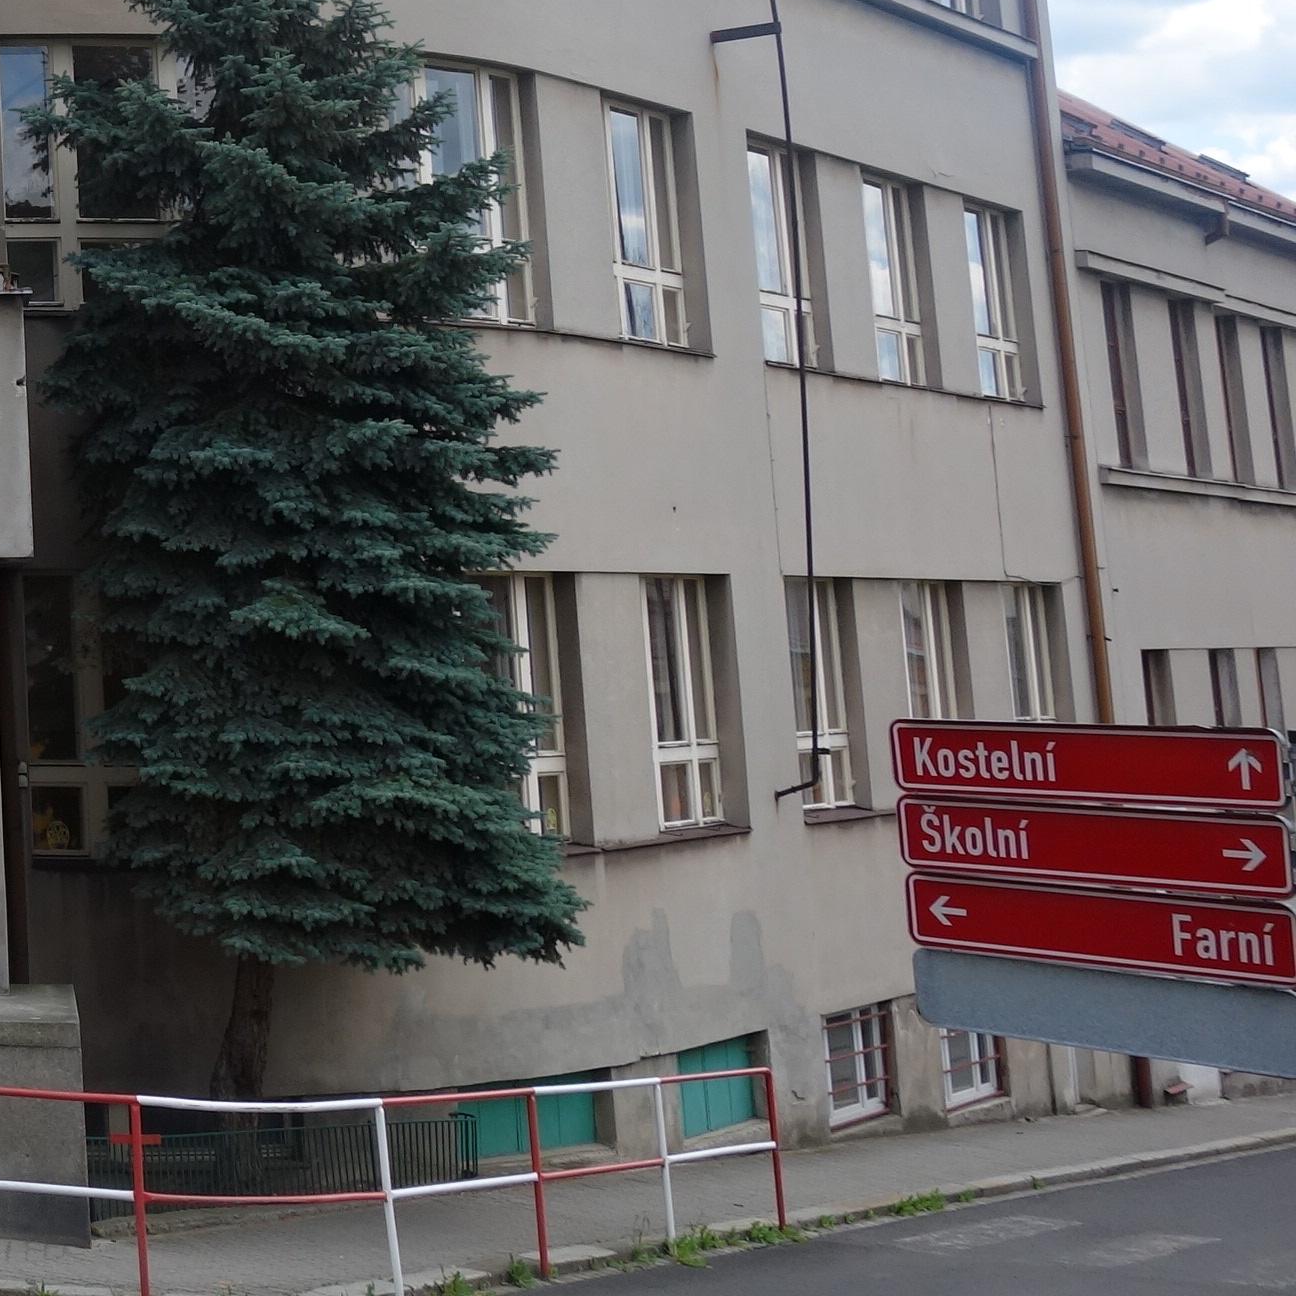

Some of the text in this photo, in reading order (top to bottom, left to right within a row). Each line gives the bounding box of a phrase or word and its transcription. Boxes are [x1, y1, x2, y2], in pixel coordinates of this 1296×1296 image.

[913, 737, 1057, 782] Kostelní
[921, 806, 1030, 860] Školní
[1171, 913, 1275, 967] Farní
